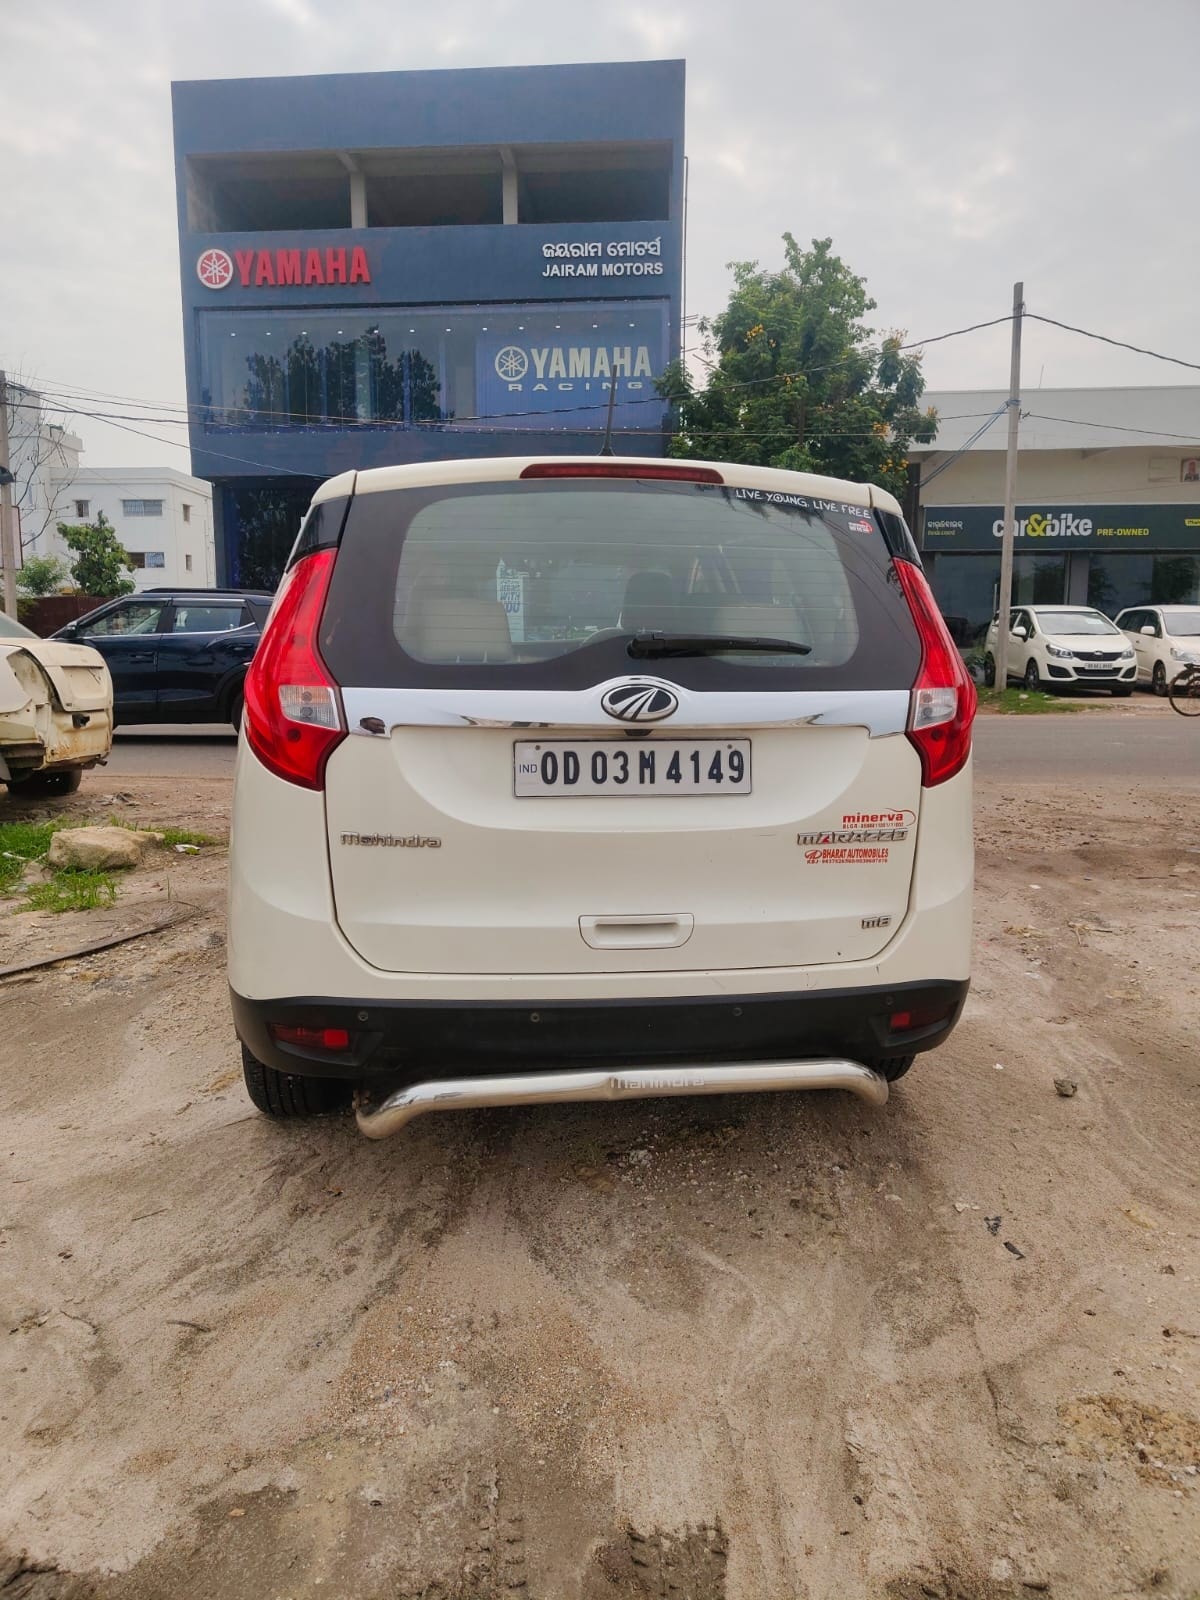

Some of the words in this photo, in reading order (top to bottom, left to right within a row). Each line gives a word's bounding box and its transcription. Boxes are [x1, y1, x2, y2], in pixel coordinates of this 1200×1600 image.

[234, 245, 371, 287] YAMAHA
[542, 263, 598, 277] JAIRAM
[602, 262, 663, 276] MOTORS
[530, 346, 652, 379] YAMAHA
[508, 381, 643, 391] RACING
[736, 489, 762, 500] LIVE
[813, 500, 839, 513] LIVE
[841, 504, 872, 519] FREE
[1097, 528, 1149, 537] PRE-OWNED
[519, 763, 538, 774] IND
[540, 751, 580, 785] OD
[591, 751, 629, 785] 03
[639, 750, 656, 784] M
[666, 750, 745, 784] 4149
[843, 812, 904, 823] minerva
[822, 849, 847, 859] BHARAT
[847, 848, 889, 859] AUTOMOBILES
